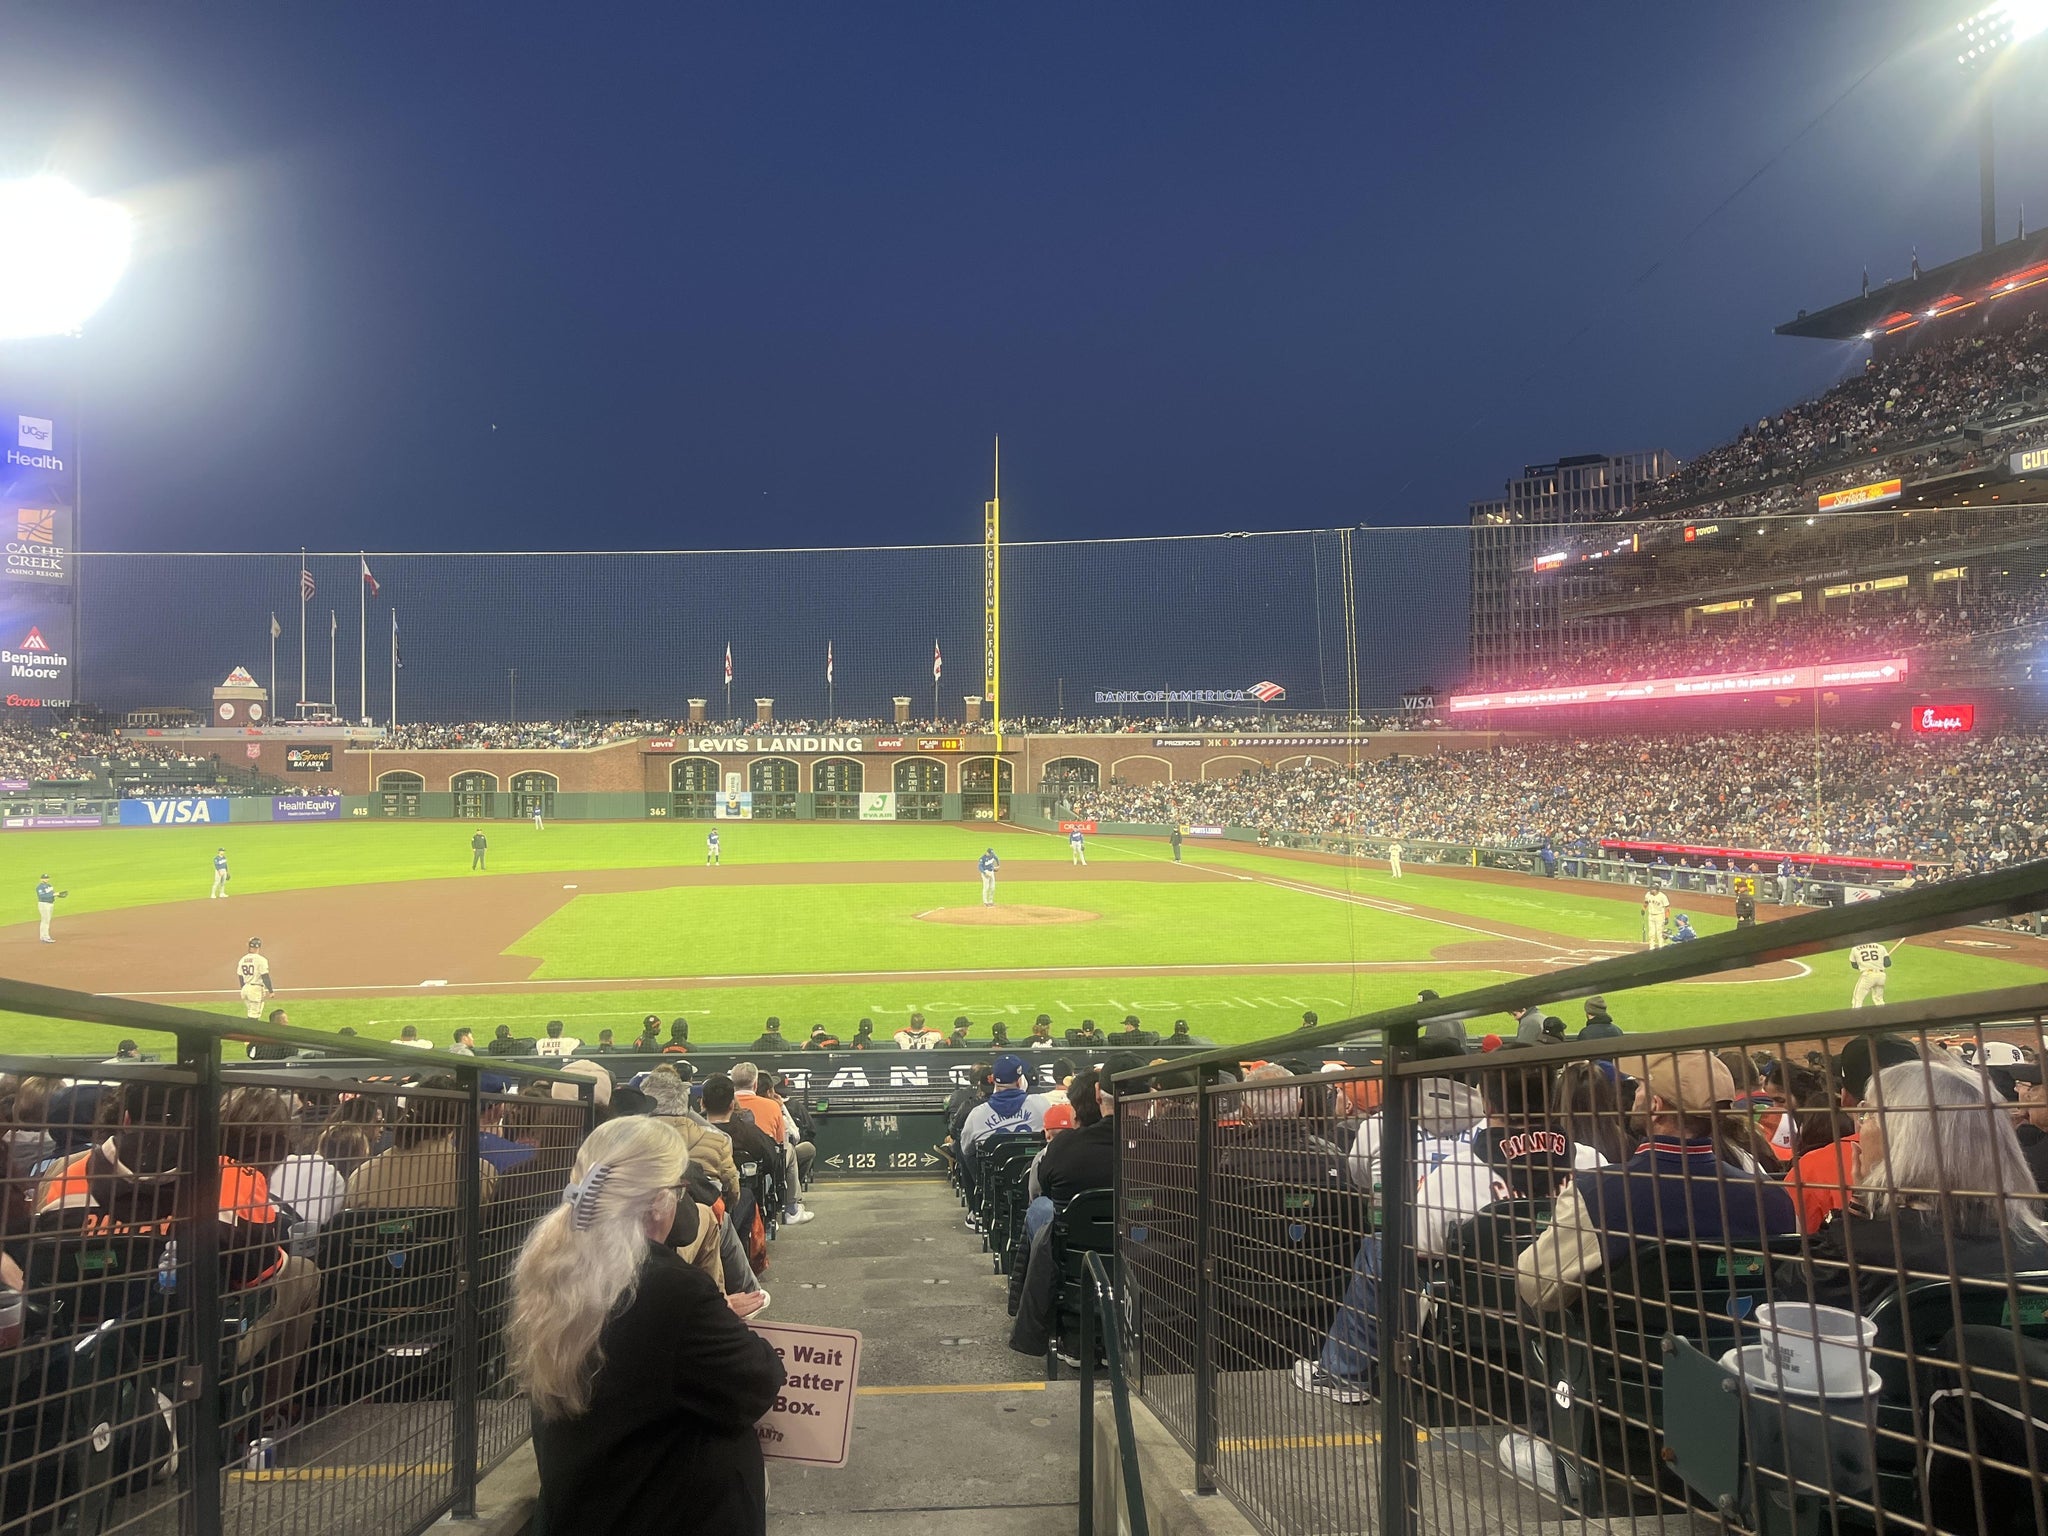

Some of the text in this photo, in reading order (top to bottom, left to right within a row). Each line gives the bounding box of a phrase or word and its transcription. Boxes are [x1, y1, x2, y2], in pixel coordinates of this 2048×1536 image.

[22, 425, 49, 440] UCSF
[7, 449, 63, 471] Health
[1834, 489, 1867, 507] Surfside
[1696, 525, 1719, 536] TOYOTA
[5, 542, 64, 558] CACHE
[7, 554, 62, 570] CREEK
[5, 567, 65, 578] CASINO RESORT
[987, 615, 994, 632] IZ
[1, 651, 68, 667] Benjamin
[11, 665, 58, 679] Moore
[6, 694, 72, 707] Coors LIGHT
[1095, 689, 1244, 703] BANK OF AMERICA
[1402, 697, 1434, 709] VISA
[756, 738, 863, 752] LANDING
[300, 750, 331, 761] Sports
[141, 800, 211, 823] VISA
[279, 800, 335, 812] HealthEquity
[353, 808, 368, 816] 415
[650, 808, 666, 816] 365
[975, 810, 993, 819] 309
[1860, 950, 1879, 962] 26
[242, 965, 254, 975] 80
[870, 1001, 1036, 1016] UCSF
[1500, 1131, 1565, 1160] GIANTS
[847, 1152, 917, 1168] 123 122
[793, 1345, 843, 1366] Wait
[772, 1395, 821, 1417] Box.
[757, 1427, 784, 1442] ANTS
